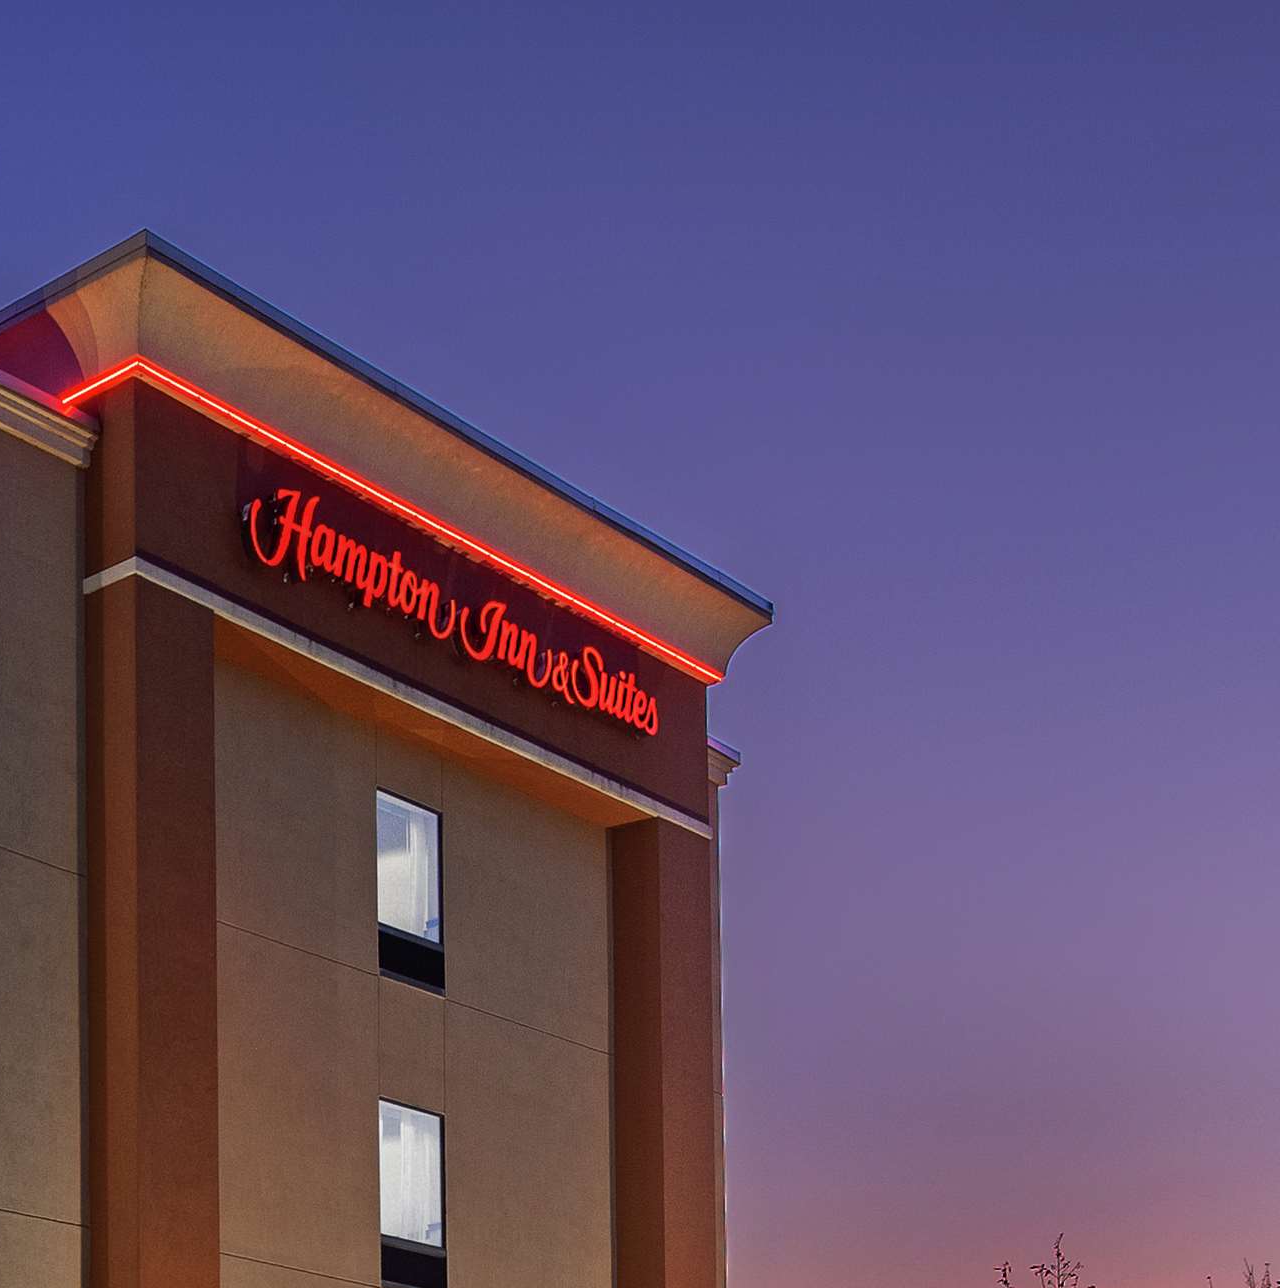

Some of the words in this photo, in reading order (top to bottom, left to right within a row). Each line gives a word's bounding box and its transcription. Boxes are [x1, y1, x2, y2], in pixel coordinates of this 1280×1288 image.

[249, 488, 456, 640] Hampton
[460, 600, 553, 689] Inn
[552, 651, 575, 705] &
[570, 645, 659, 736] Suites
